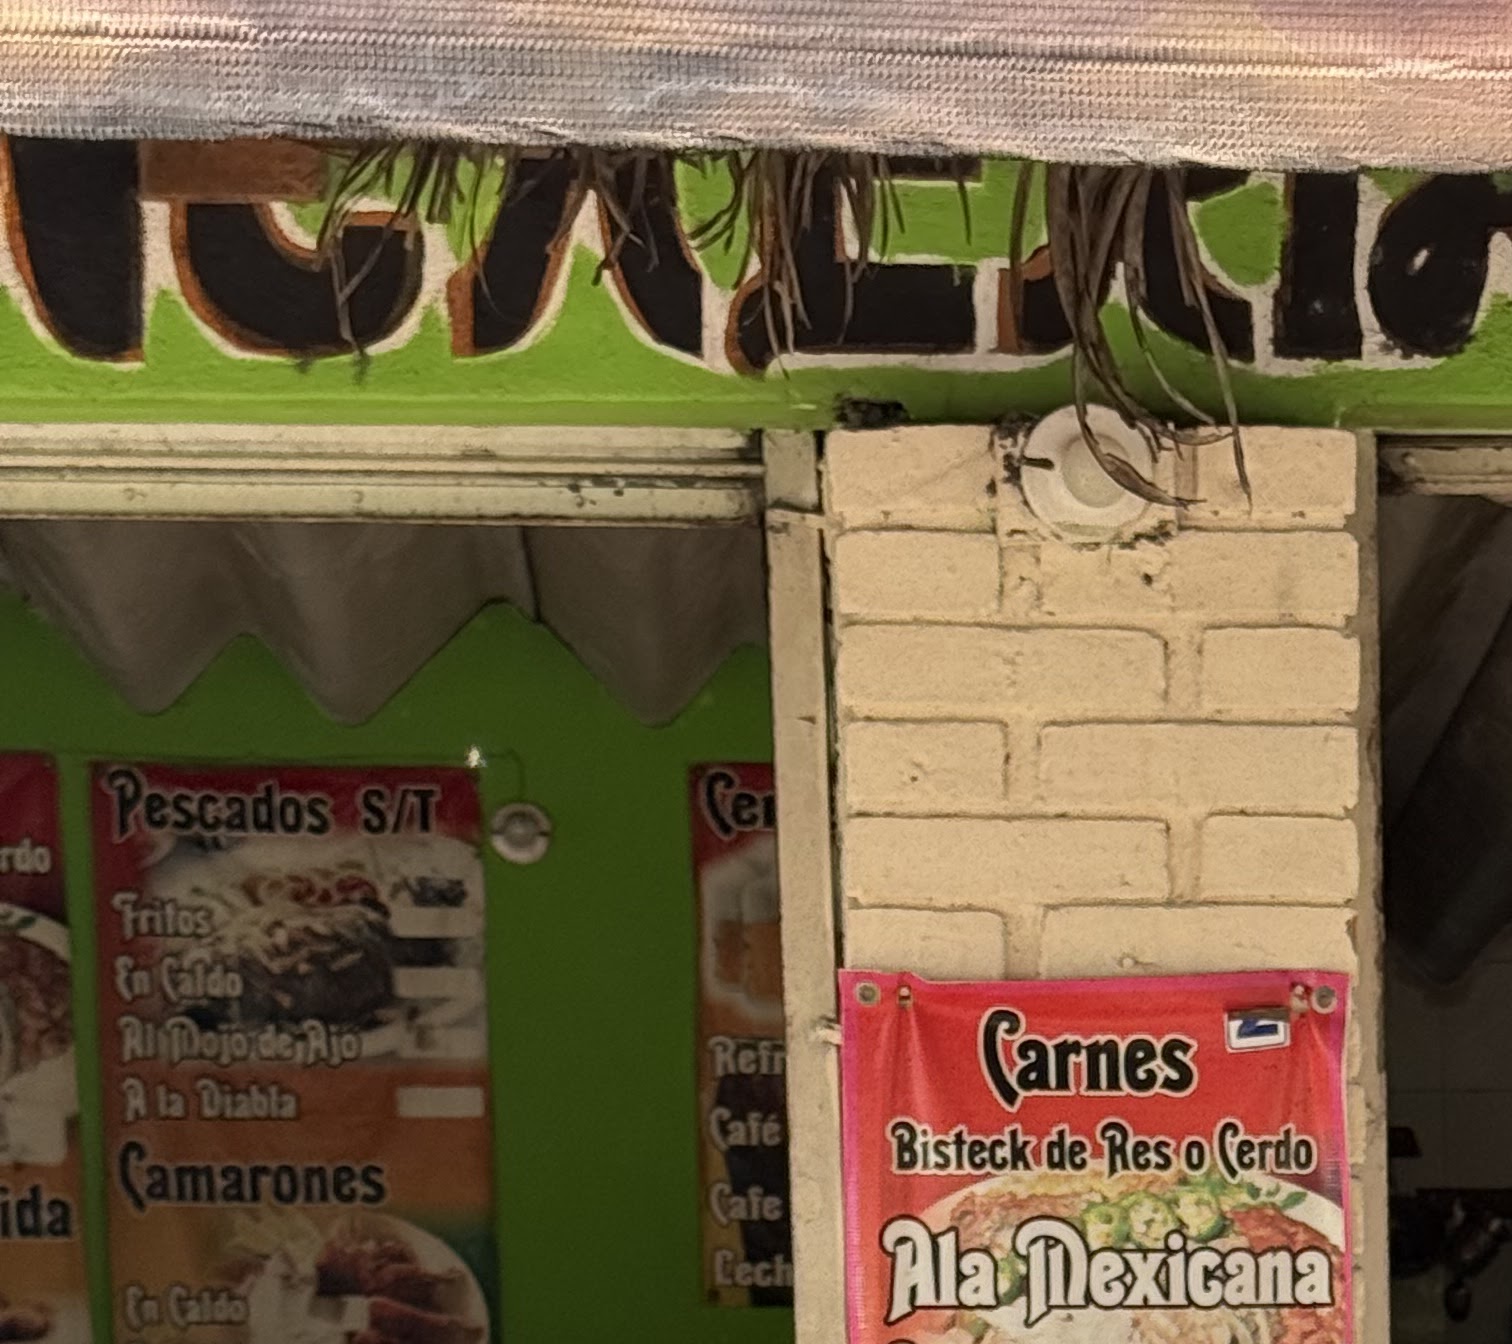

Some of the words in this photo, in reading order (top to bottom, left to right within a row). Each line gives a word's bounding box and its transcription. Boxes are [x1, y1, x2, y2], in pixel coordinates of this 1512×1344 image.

[106, 769, 331, 841] Pescados
[362, 787, 440, 834] S/T
[113, 892, 213, 940] Fritos
[161, 957, 244, 999] Caldo
[709, 1035, 787, 1079] Refr
[981, 1008, 1196, 1110] Carnes
[196, 1077, 299, 1120] Diabla
[119, 1141, 386, 1212] Camarones
[889, 1121, 1037, 1174] Bisteck
[1045, 1126, 1089, 1171] de
[1099, 1121, 1172, 1179] Res
[1185, 1133, 1203, 1170] o
[1218, 1120, 1315, 1180] Cerdo
[1012, 1219, 1334, 1328] Mexicana
